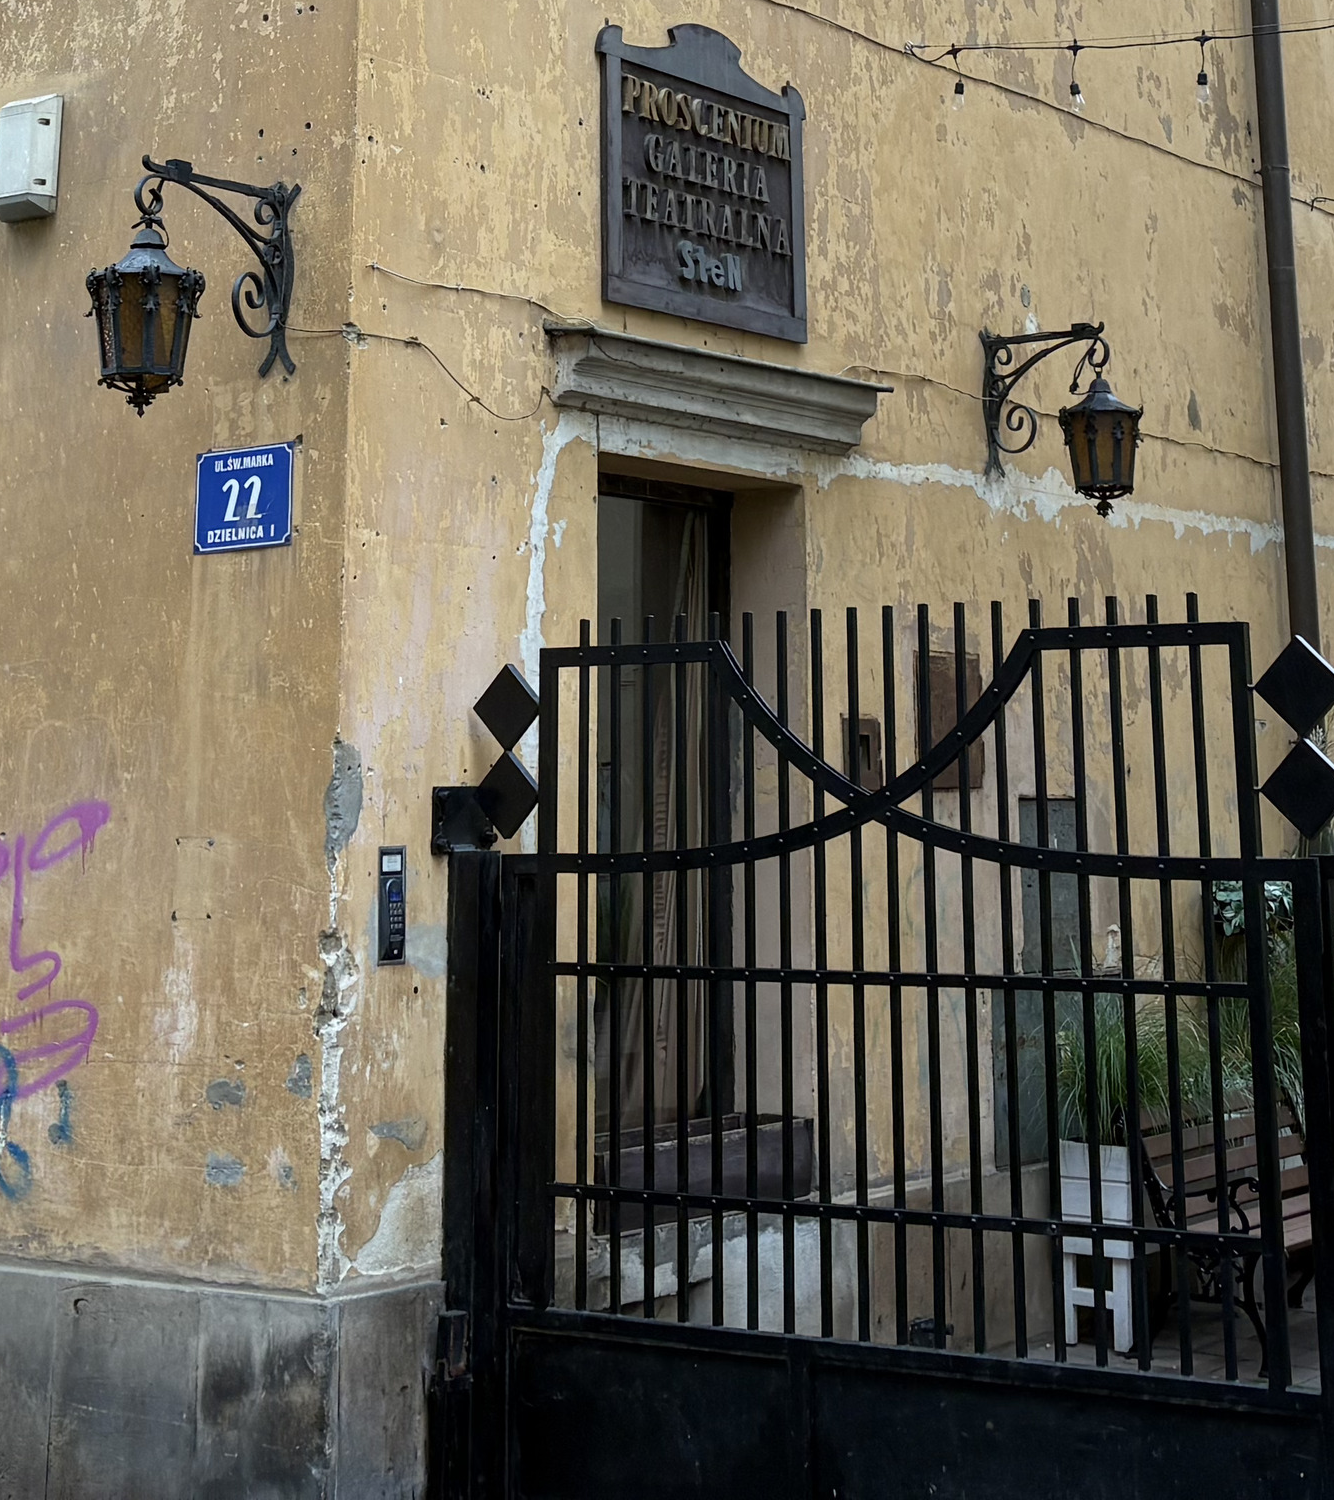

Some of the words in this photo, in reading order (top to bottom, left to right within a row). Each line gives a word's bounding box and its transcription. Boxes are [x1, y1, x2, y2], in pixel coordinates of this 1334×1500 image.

[621, 73, 792, 161] PROSCENIUM
[644, 133, 771, 203] GALERIA
[623, 176, 792, 256] TEATRALNA
[222, 475, 263, 522] 22
[207, 525, 264, 544] DZIELNICA
